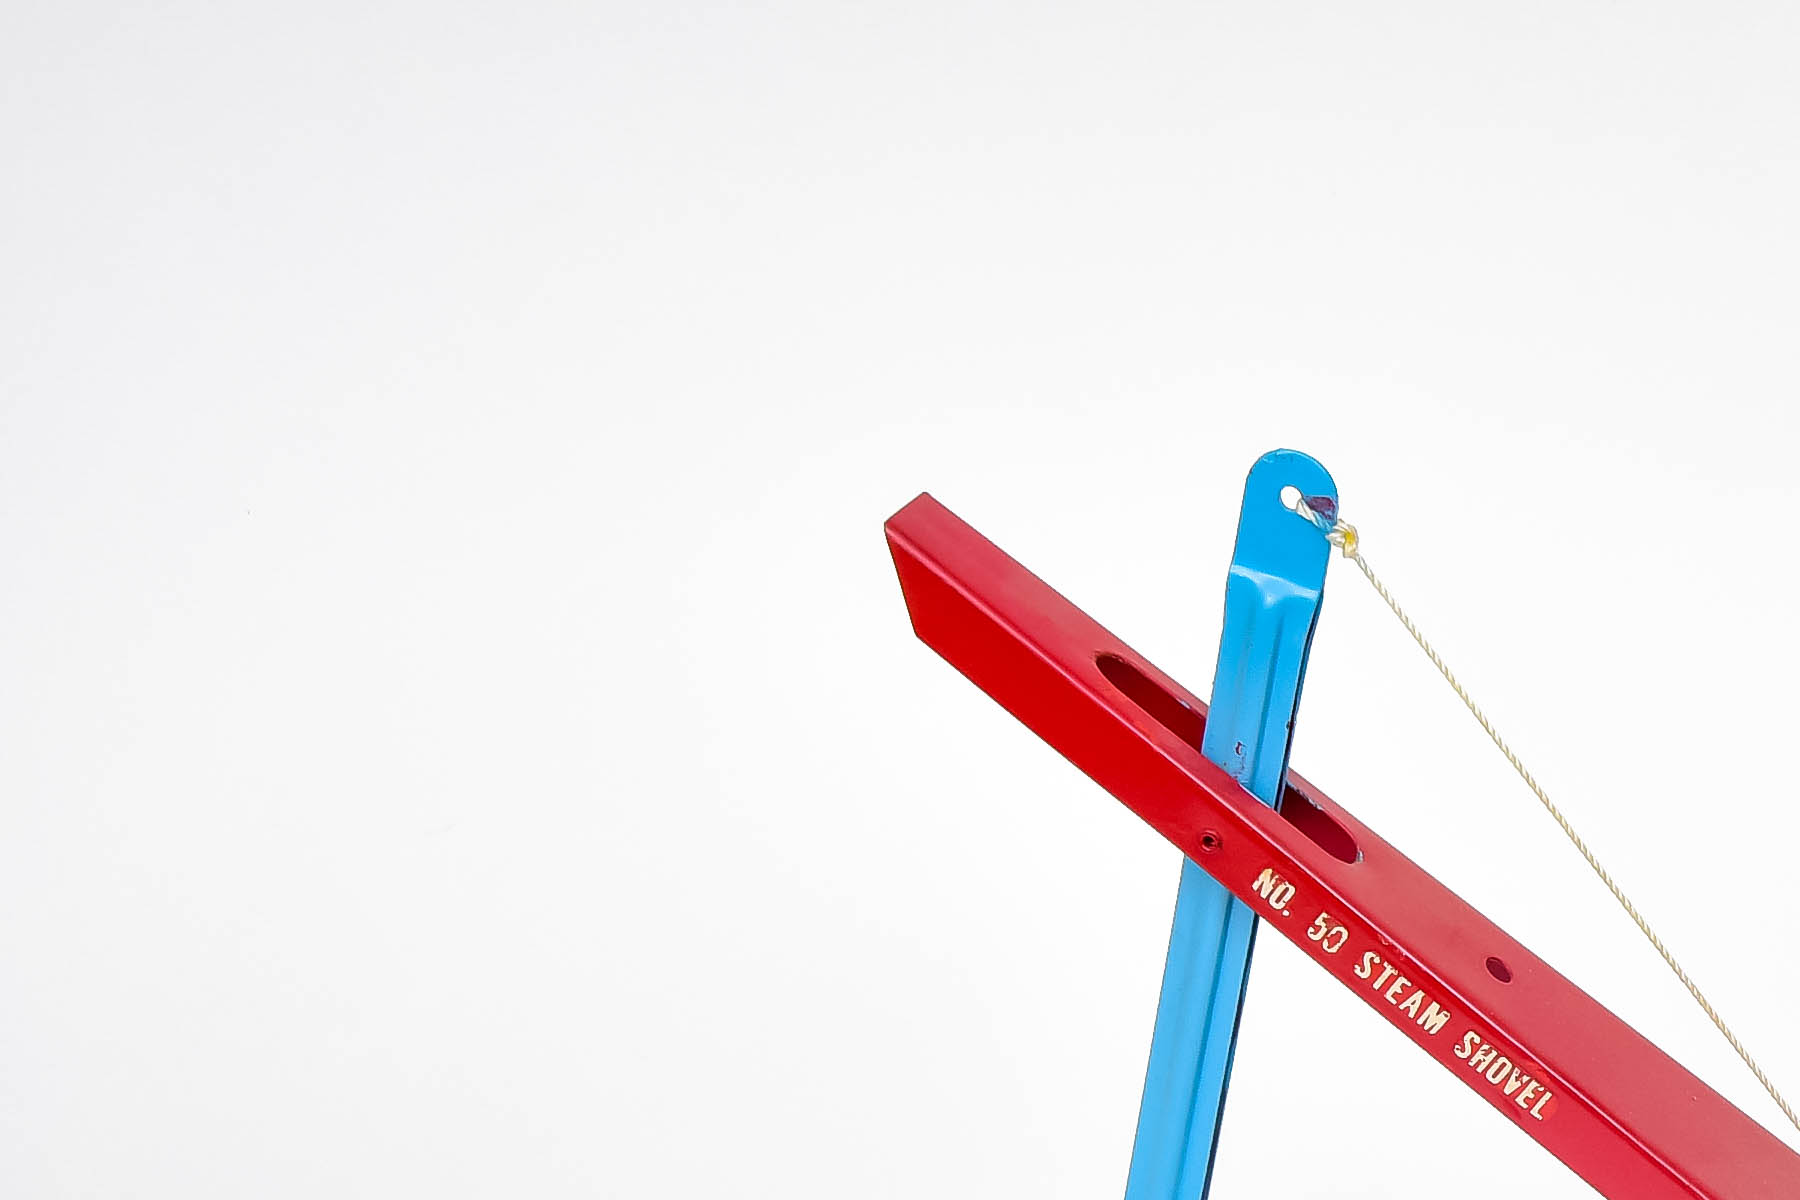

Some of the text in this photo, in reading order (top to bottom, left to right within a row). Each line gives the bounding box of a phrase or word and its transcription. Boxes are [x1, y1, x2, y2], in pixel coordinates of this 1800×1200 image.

[1251, 868, 1553, 1121] NO. 50 STEAM SHOVEL
